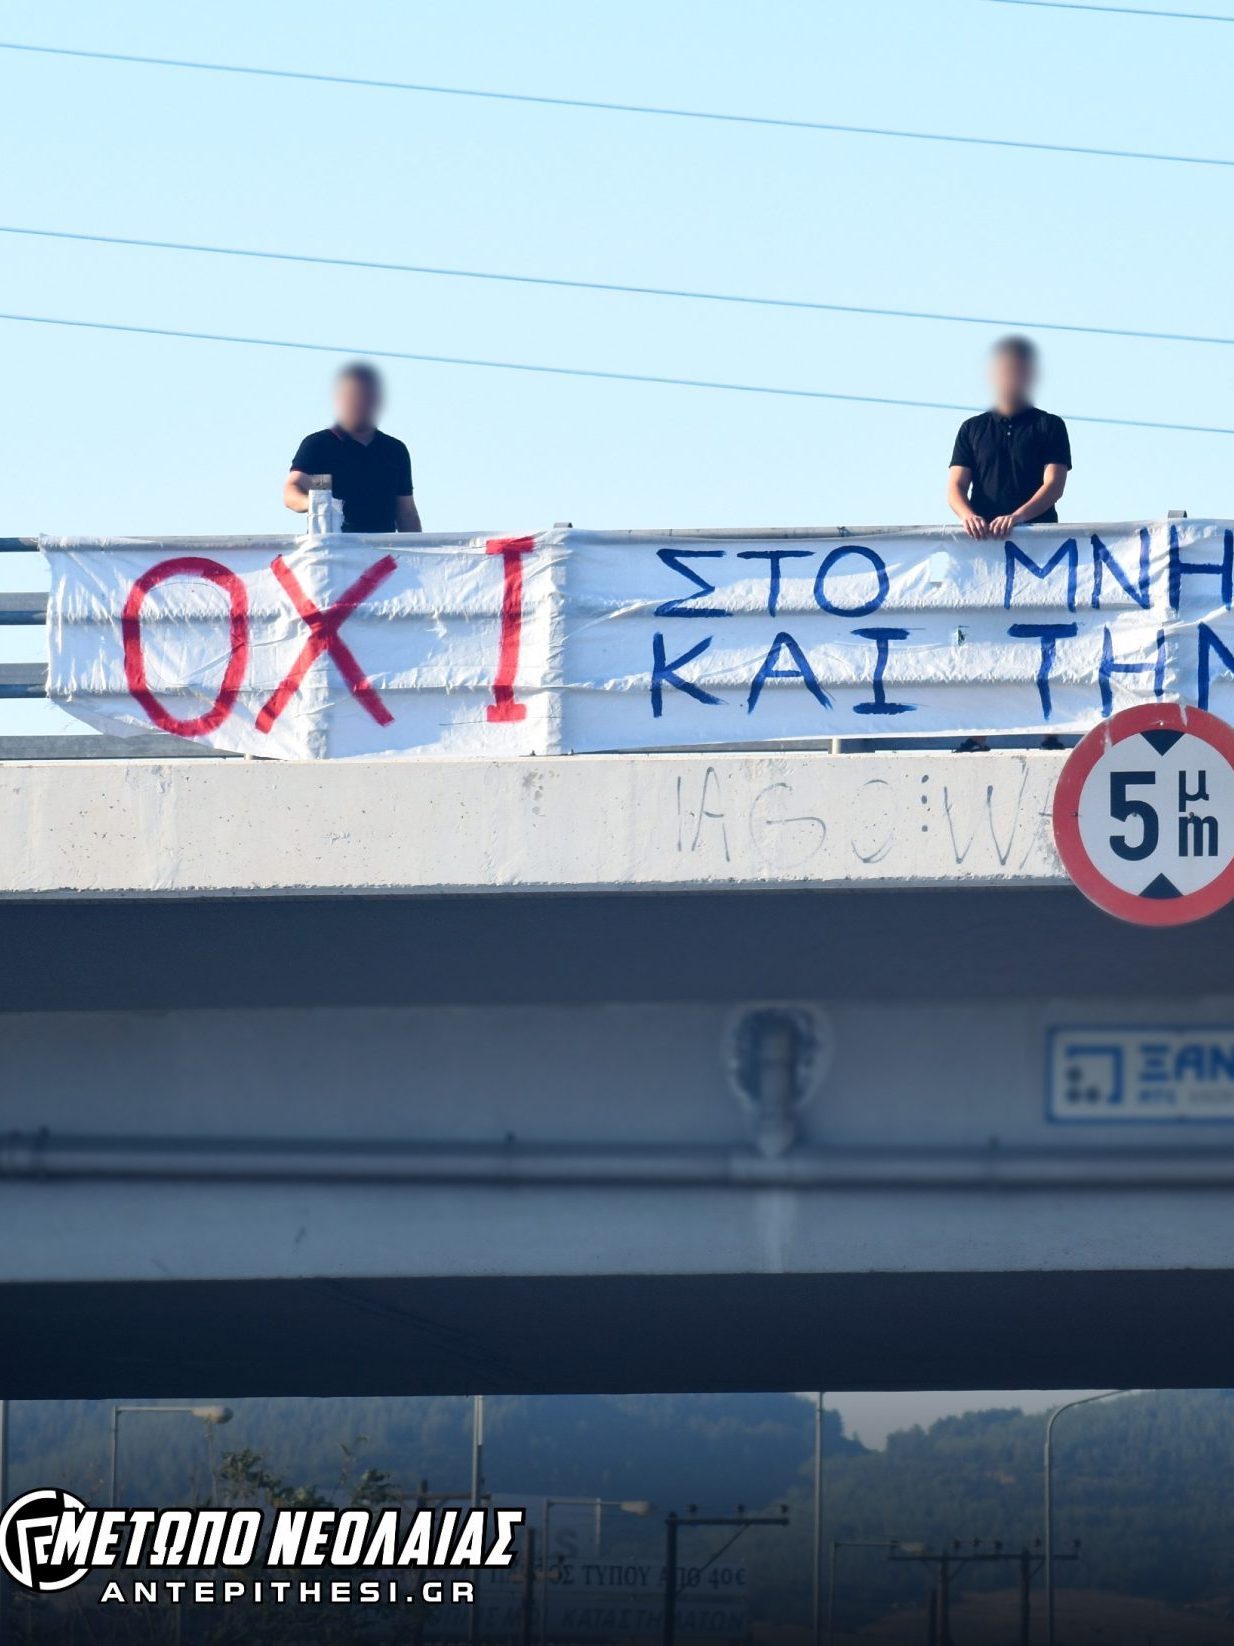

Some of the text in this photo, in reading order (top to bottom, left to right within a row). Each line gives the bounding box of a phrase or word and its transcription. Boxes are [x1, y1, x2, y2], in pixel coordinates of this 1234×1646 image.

[654, 547, 890, 618] ΣΤΟ
[123, 536, 535, 738] ΟΧΙ
[650, 627, 916, 720] ΚΑΙ
[1109, 770, 1159, 861] 5
[1178, 815, 1219, 857] m
[581, 1564, 651, 1586] ΤΥΠΟΥ
